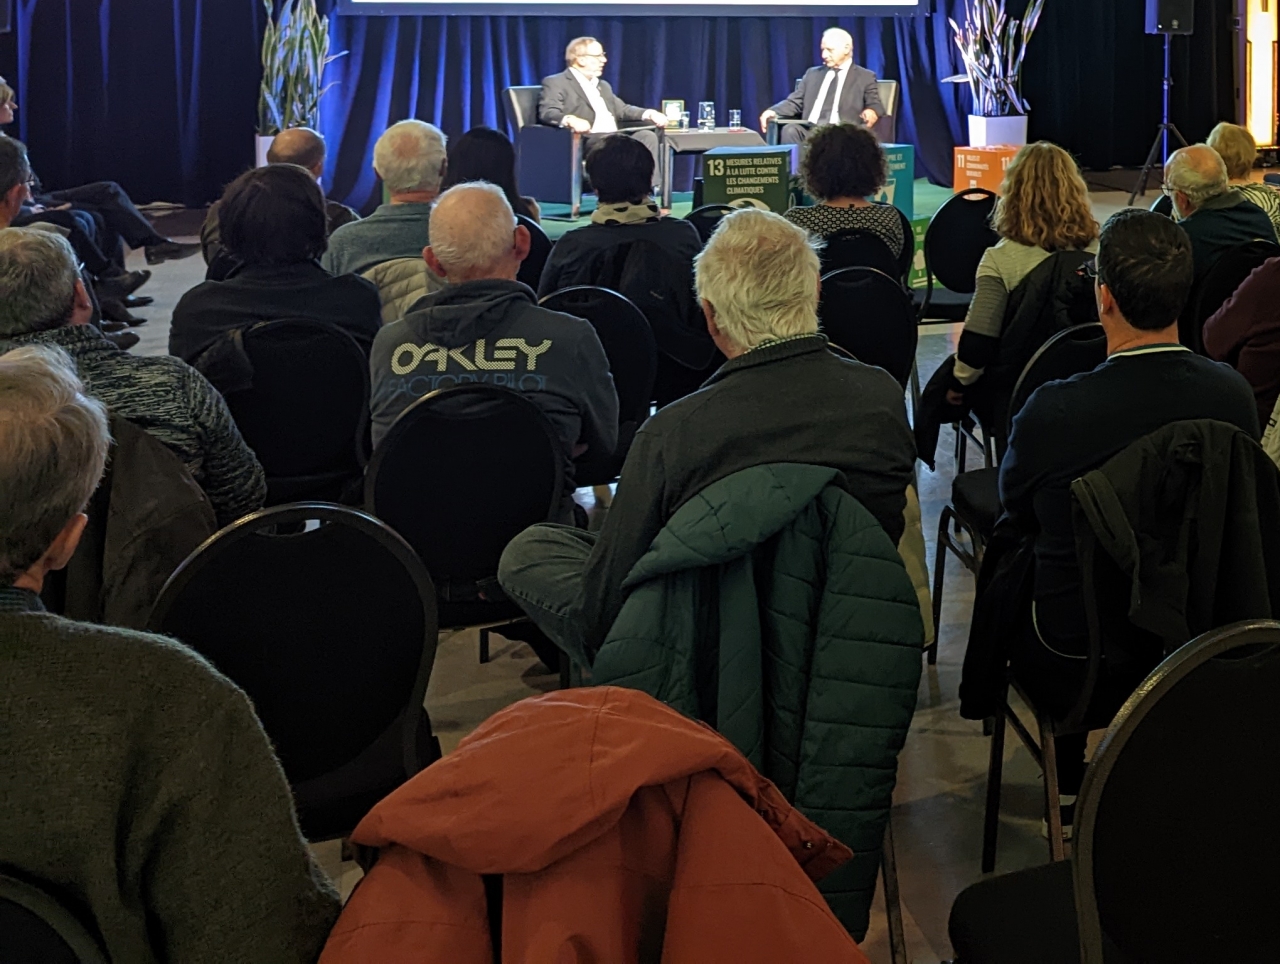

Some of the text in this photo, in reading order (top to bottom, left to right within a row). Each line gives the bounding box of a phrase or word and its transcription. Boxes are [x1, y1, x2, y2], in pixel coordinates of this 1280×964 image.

[726, 157, 782, 166] MESURES RELATIVES
[957, 154, 965, 168] 11
[1001, 157, 1010, 171] 11
[707, 159, 725, 176] 13
[739, 167, 756, 175] LUTTE
[737, 176, 780, 185] CHANGEMENTS
[726, 186, 764, 195] CLIMATIQUES
[390, 338, 553, 375] OAKLEY
